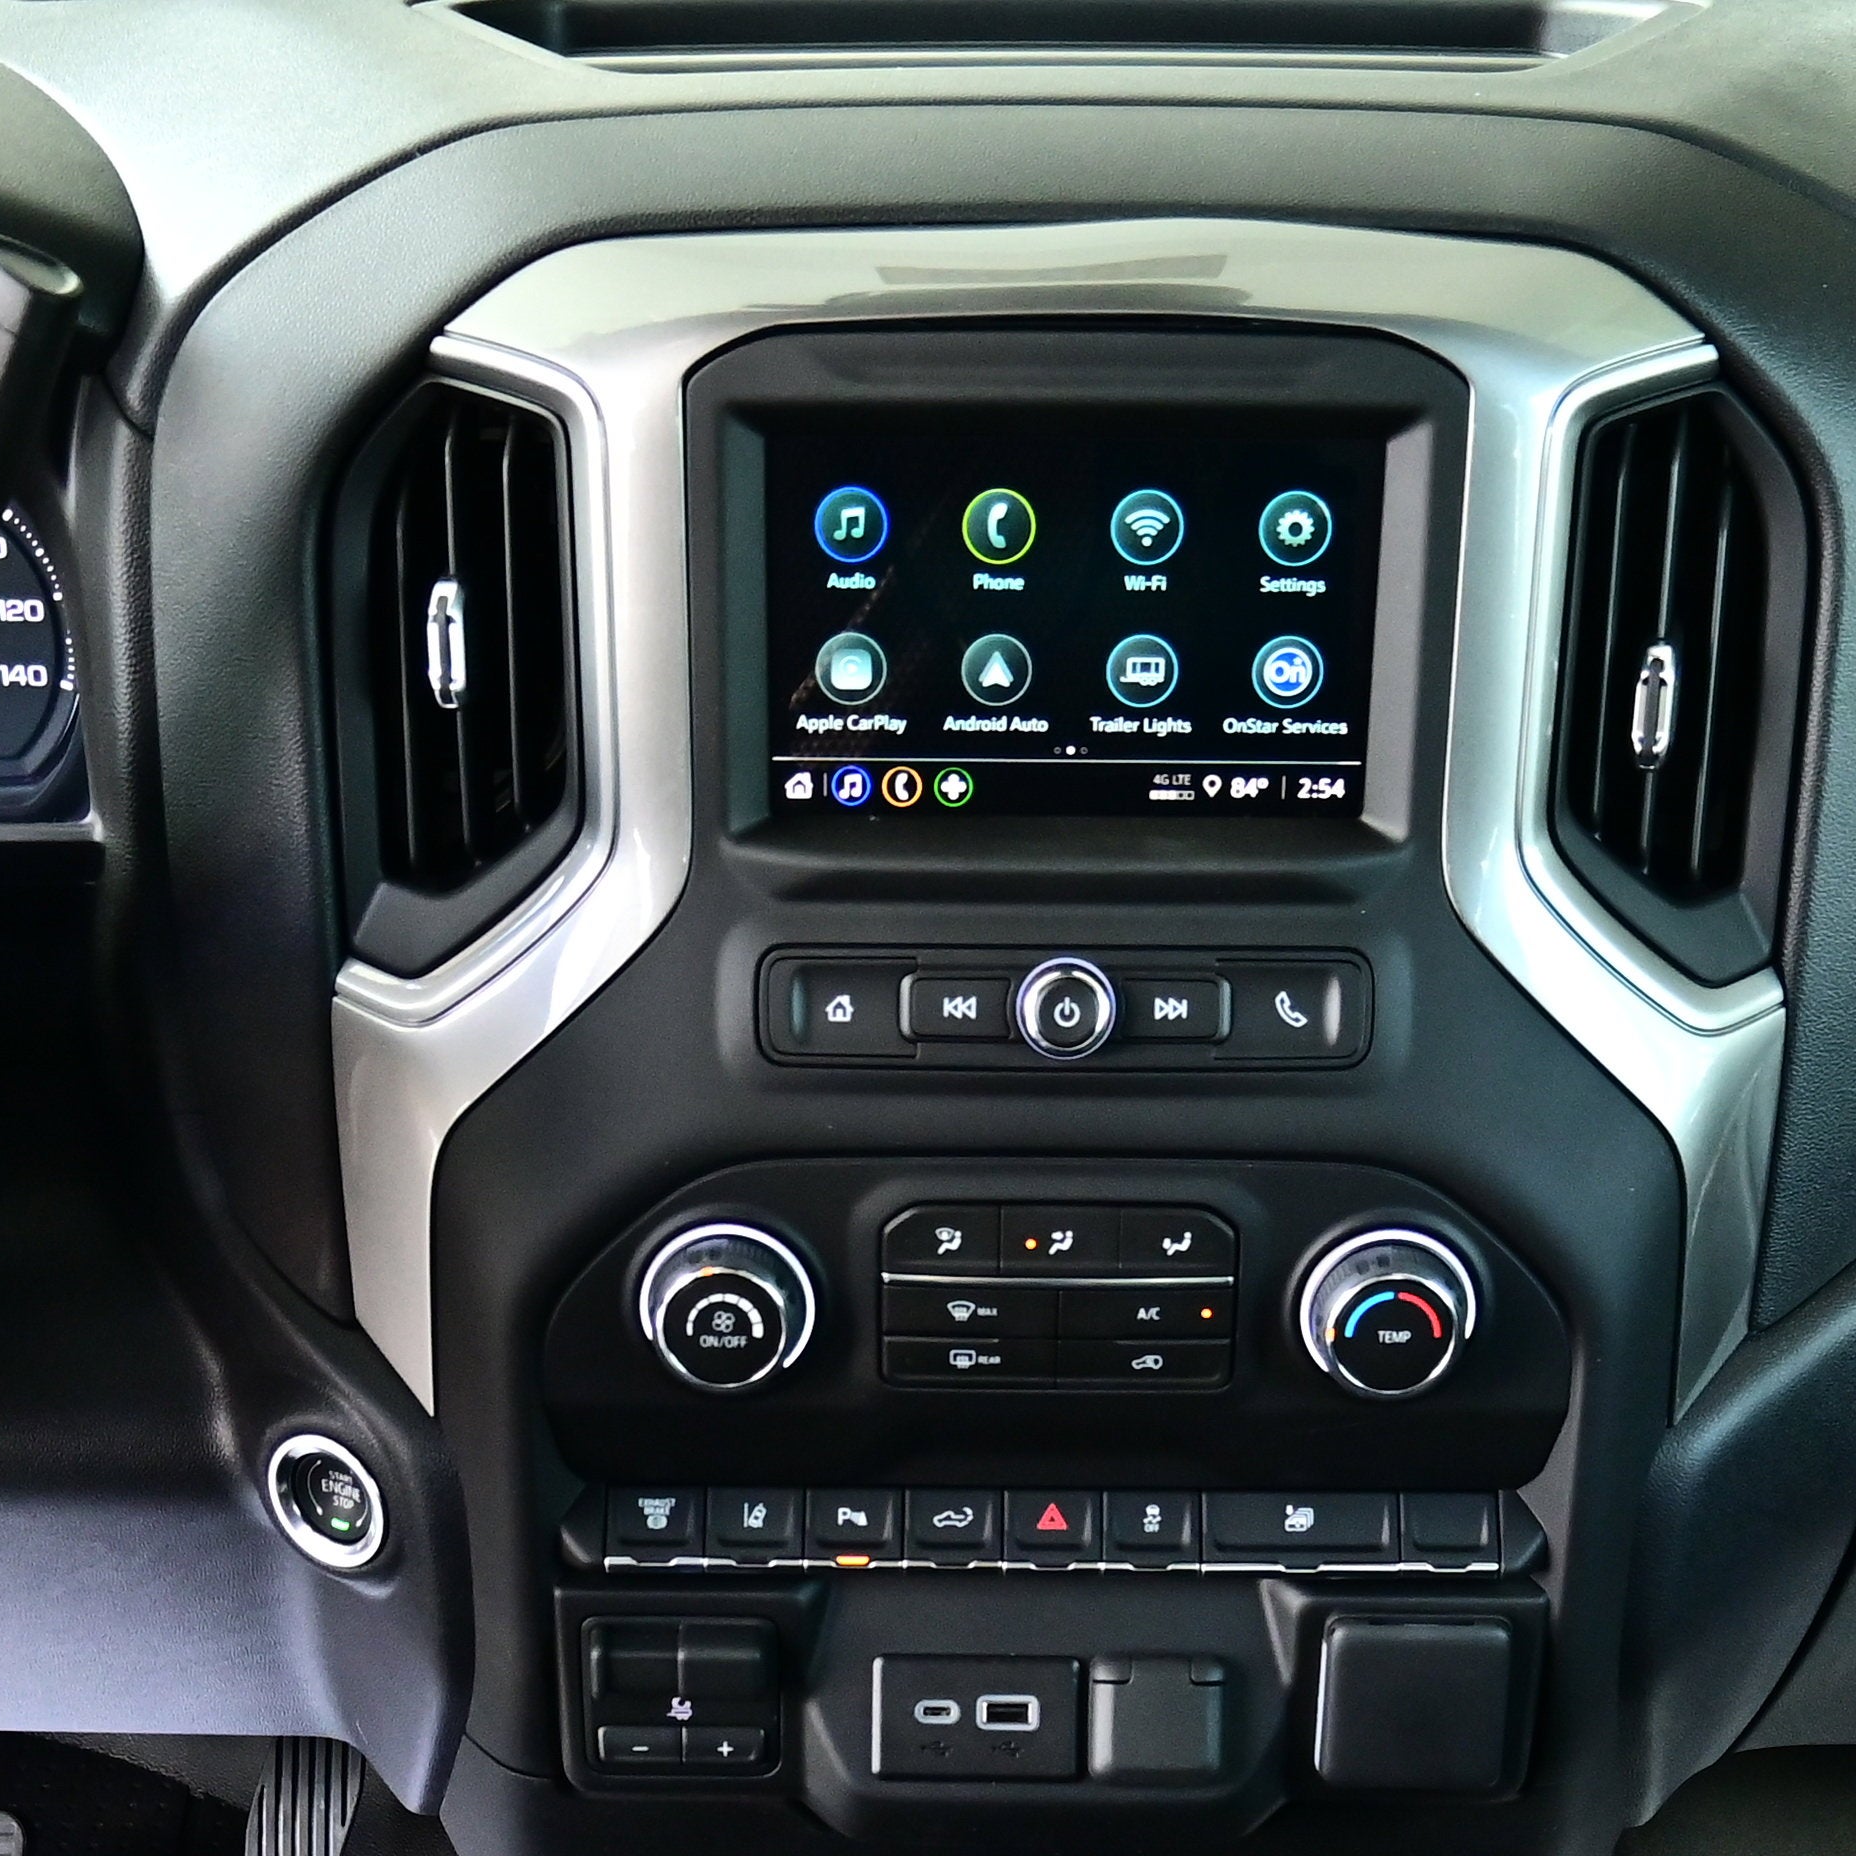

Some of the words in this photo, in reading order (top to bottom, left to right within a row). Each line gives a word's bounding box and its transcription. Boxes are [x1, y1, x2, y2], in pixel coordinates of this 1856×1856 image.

[826, 572, 877, 590] Audio
[972, 573, 1025, 591] Phone
[1123, 574, 1168, 591] Wi-Fi
[1259, 575, 1327, 597] Settings
[796, 714, 844, 735] Apple
[846, 714, 907, 735] CarPlay
[943, 715, 1008, 733] Android
[1009, 715, 1049, 733] Auto
[1089, 716, 1140, 734] Trailer
[1143, 716, 1192, 737] Lights
[1222, 717, 1280, 735] OnStar
[1281, 718, 1349, 736] Services
[1152, 774, 1170, 785] 4G
[1172, 774, 1192, 786] LTE
[1296, 777, 1346, 799] 2:54
[1136, 1306, 1161, 1321] A/C
[699, 1334, 748, 1350] ON/OFF
[1377, 1329, 1412, 1345] TEMP
[321, 1478, 361, 1504] ENGINE
[332, 1494, 355, 1510] STOP
